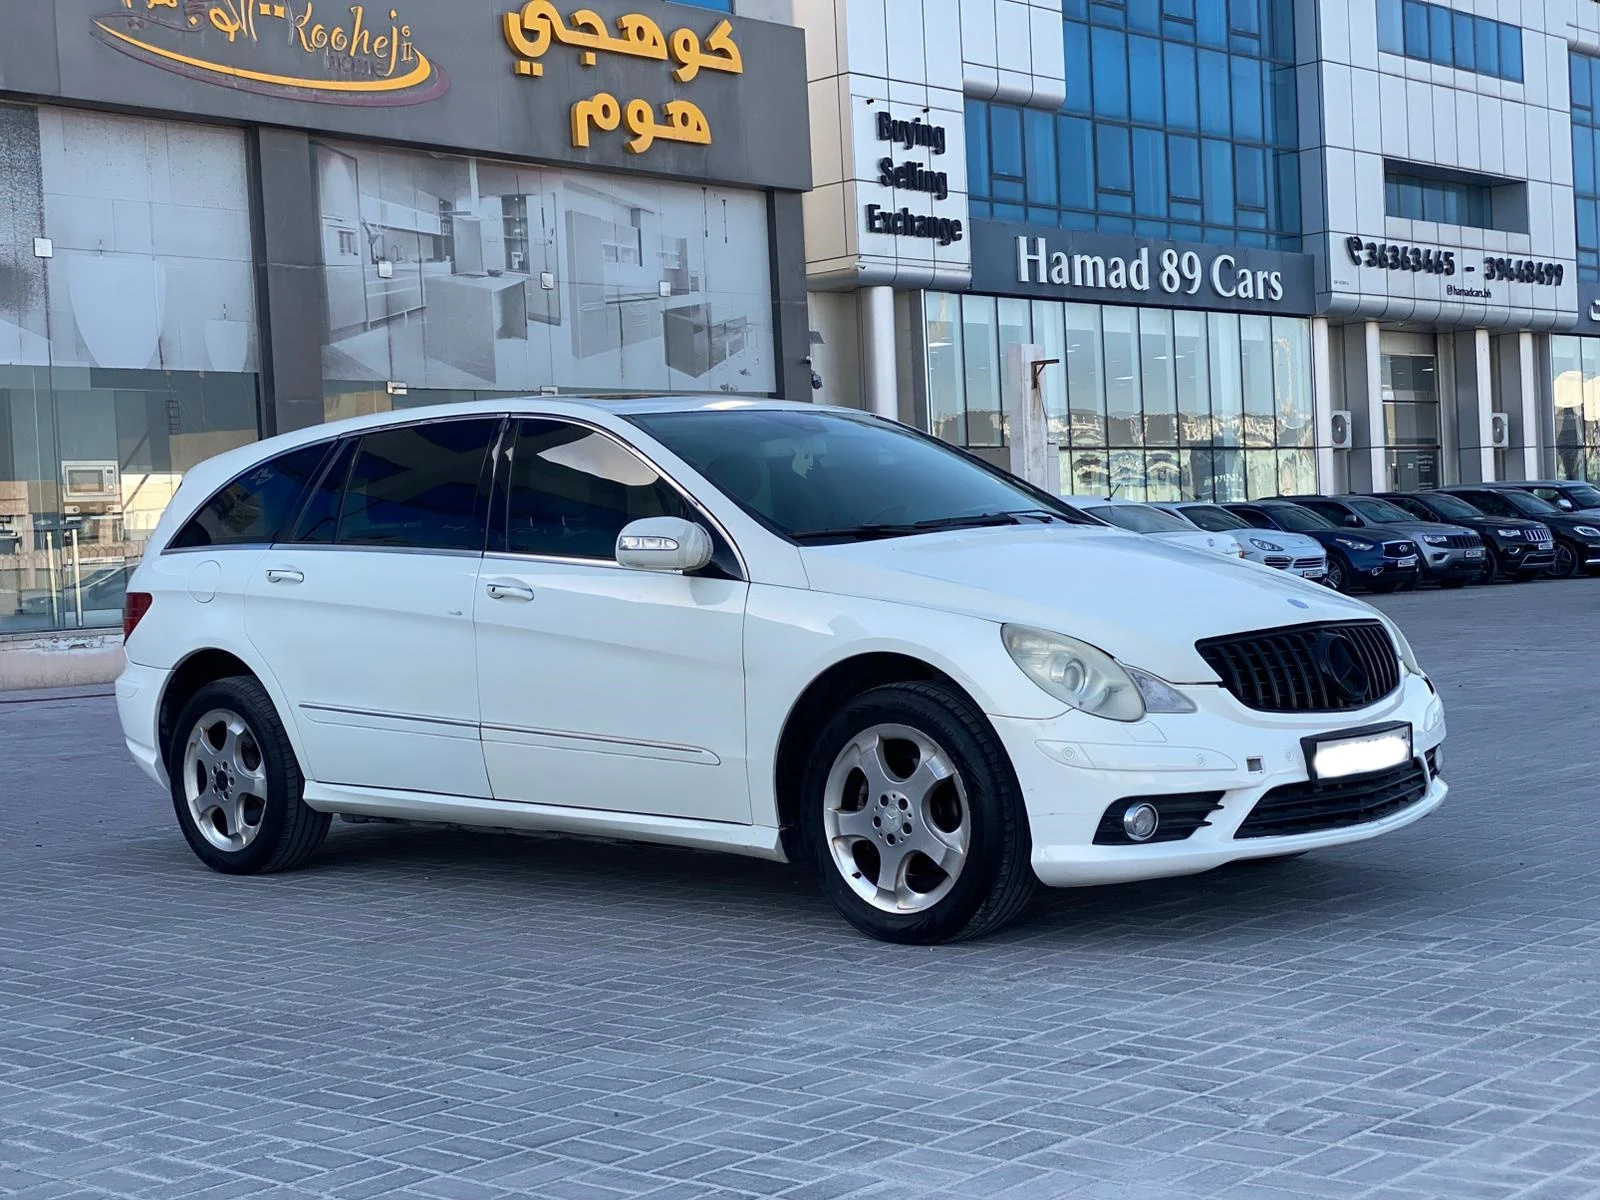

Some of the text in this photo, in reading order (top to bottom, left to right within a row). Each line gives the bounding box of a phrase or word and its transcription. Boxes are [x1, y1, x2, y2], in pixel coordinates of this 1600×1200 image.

[503, 0, 744, 83] كوهجي
[571, 92, 712, 154] هوم
[876, 111, 946, 155] Buying
[879, 157, 948, 200] Selling
[866, 203, 963, 246] Exchange
[1015, 235, 1284, 301] Hamad 89 Cars
